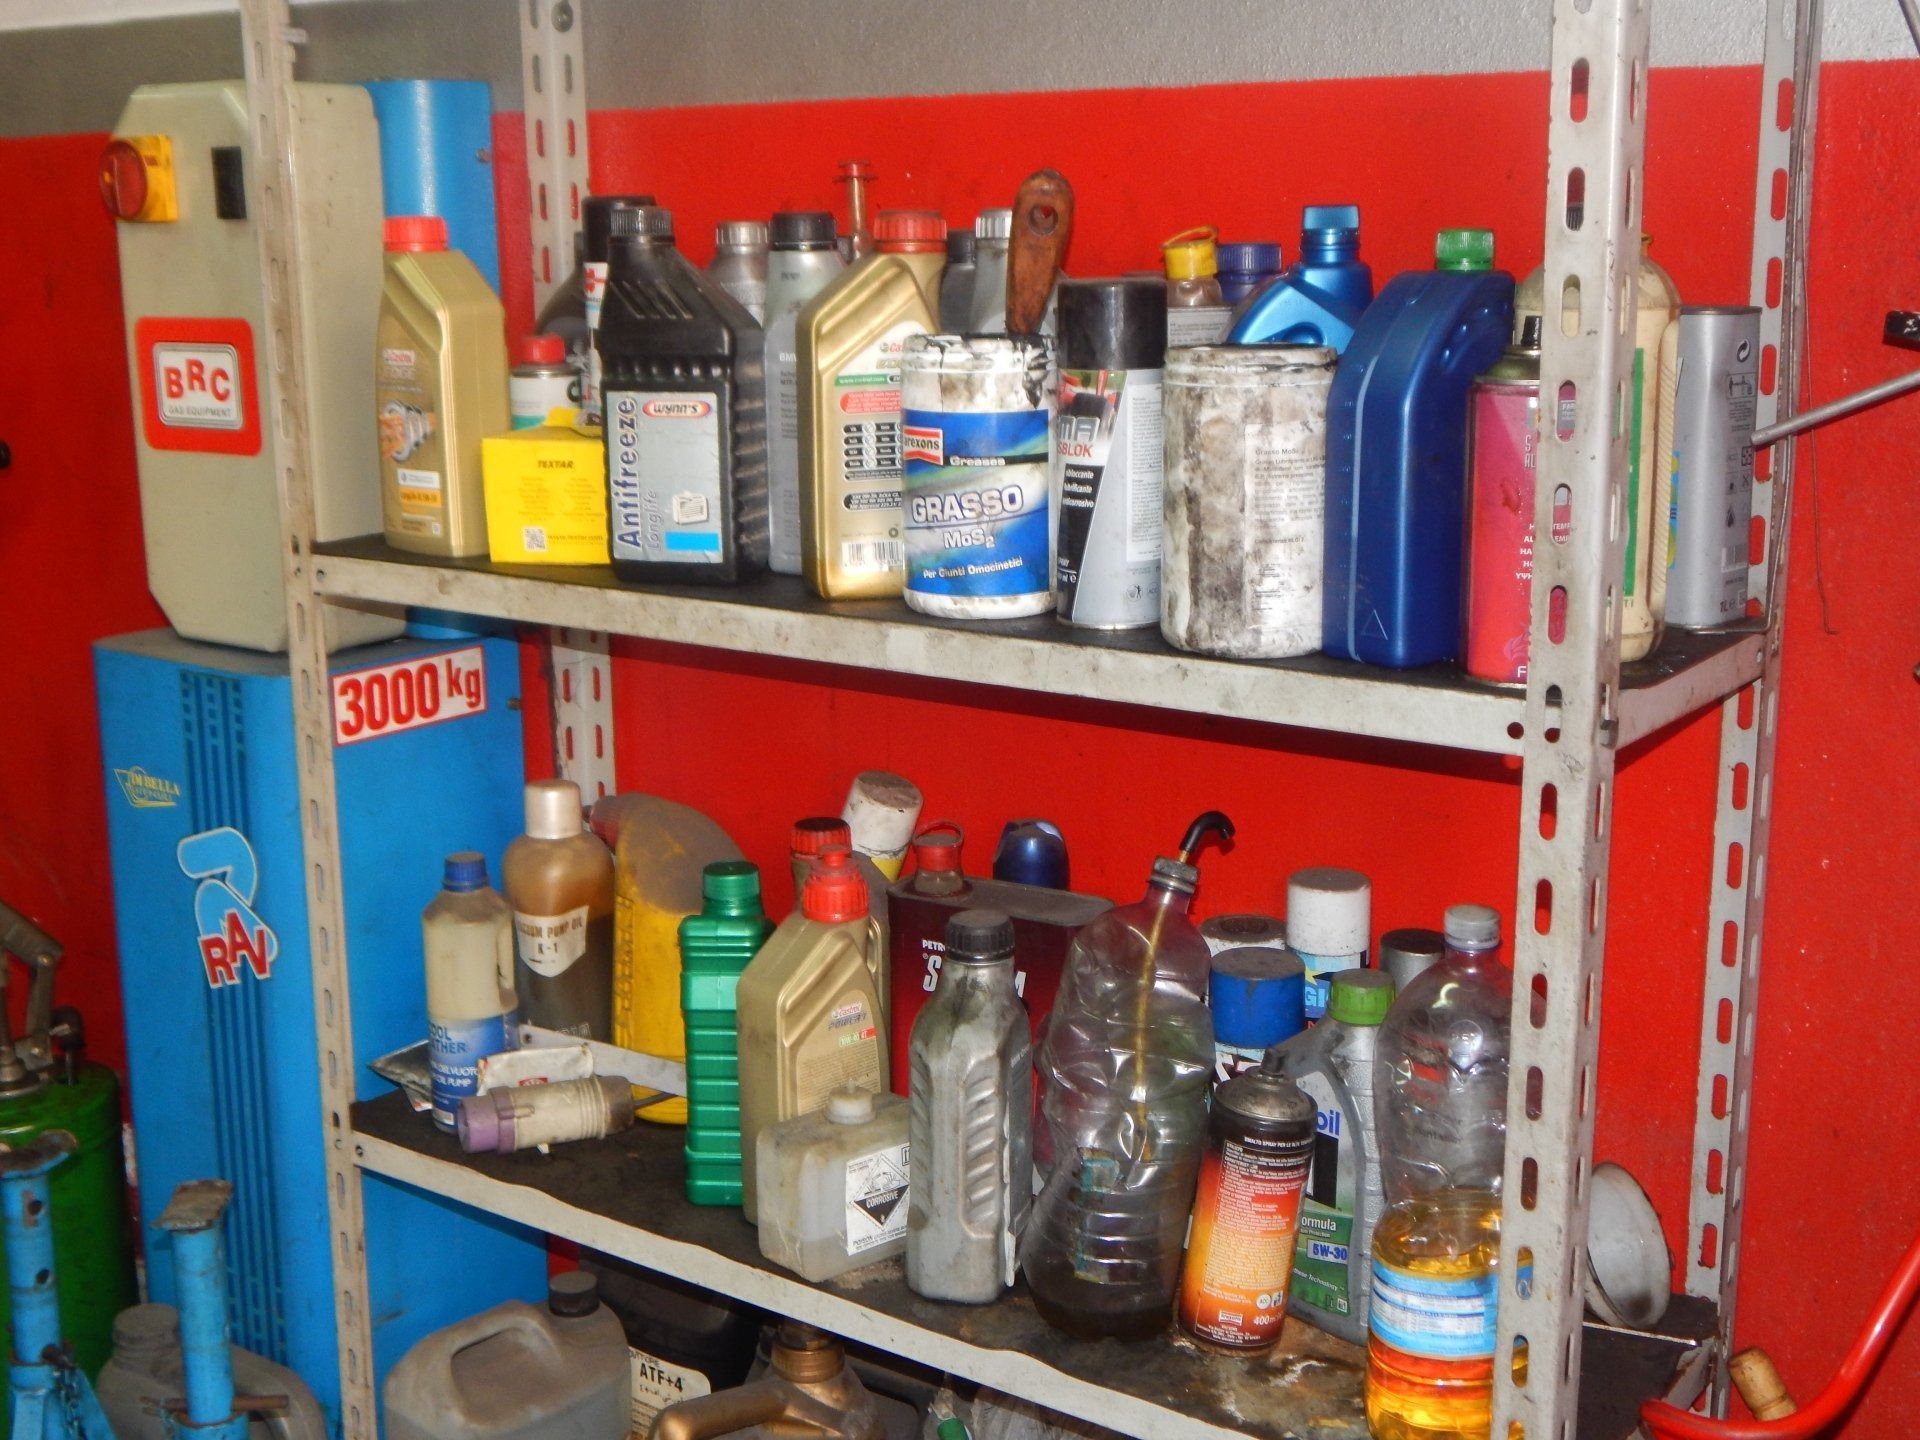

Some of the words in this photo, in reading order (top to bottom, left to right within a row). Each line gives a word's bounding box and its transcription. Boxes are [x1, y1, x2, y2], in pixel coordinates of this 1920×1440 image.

[163, 358, 230, 402] BRC
[168, 405, 184, 415] GAS
[186, 406, 232, 416] EQUIPMENT
[904, 436, 940, 450] arexons
[537, 460, 574, 469] TEXTAR
[950, 455, 1006, 466] Greases
[612, 398, 642, 549] Antifreeze
[912, 484, 1024, 524] GRASSO
[923, 569, 937, 579] Per
[939, 566, 966, 578] Giunti
[967, 556, 1023, 575] Omocinetici
[337, 662, 440, 737] 3000
[445, 658, 482, 709] kg
[548, 921, 569, 938] PUMP
[199, 909, 270, 987] RAV
[866, 1190, 899, 1209] CORROSIVE
[1301, 1216, 1337, 1231] ormula
[1312, 1242, 1348, 1260] 5W-30
[1308, 1273, 1338, 1291] Technology
[1253, 1315, 1270, 1326] 400
[639, 1362, 683, 1393] ATF+4
